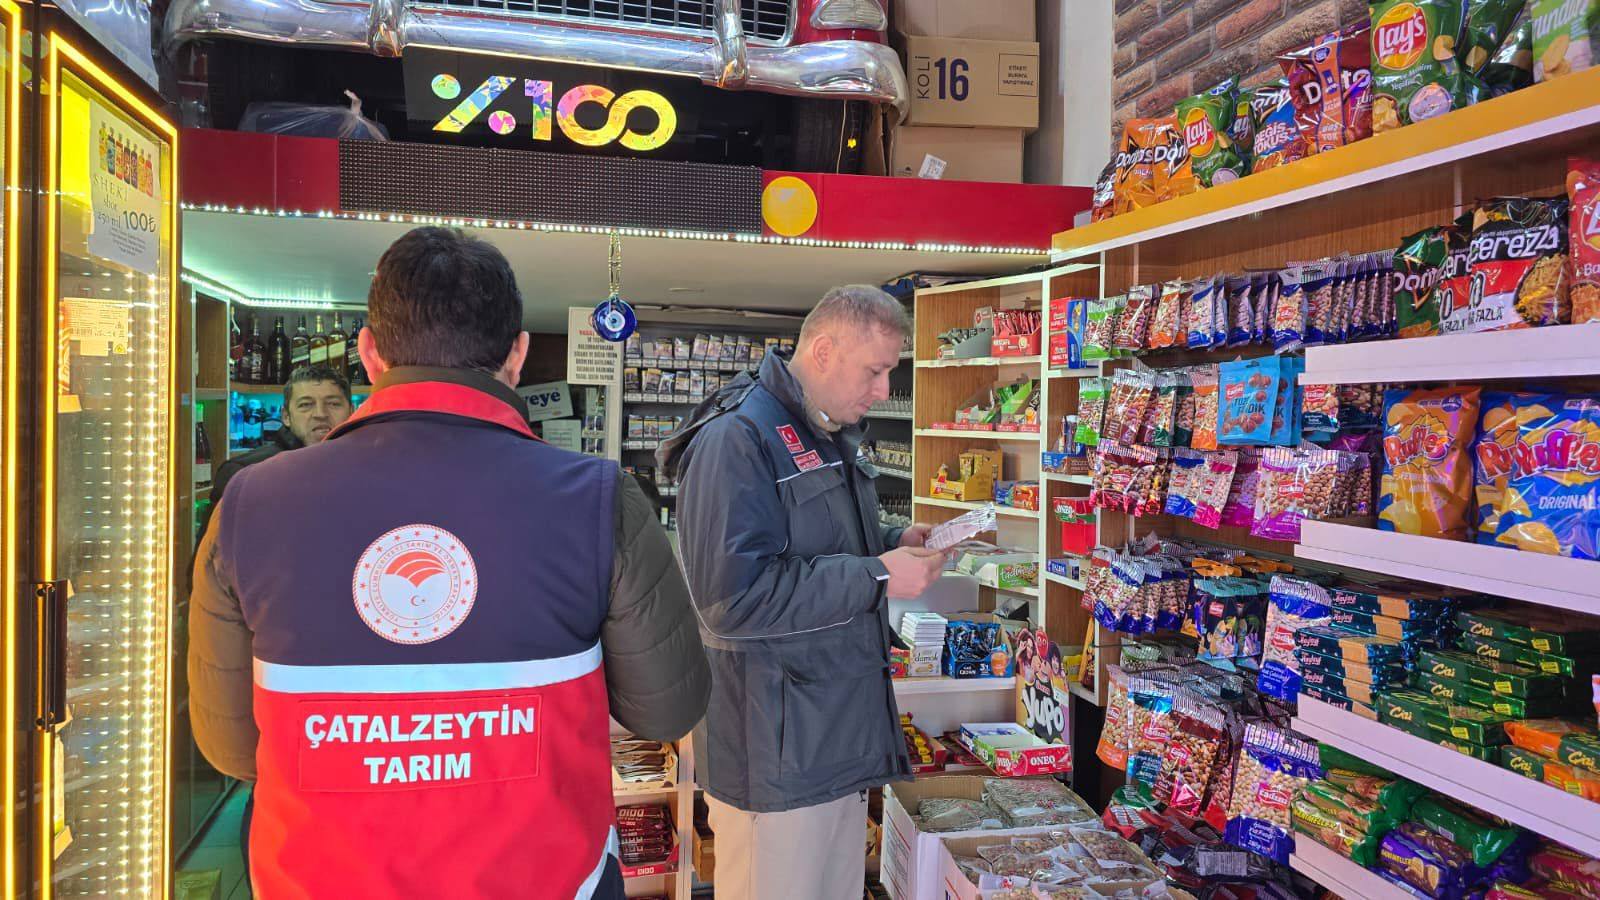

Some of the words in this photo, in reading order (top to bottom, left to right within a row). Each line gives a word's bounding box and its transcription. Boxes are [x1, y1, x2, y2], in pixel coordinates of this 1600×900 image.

[1378, 14, 1426, 58] Lay's
[934, 57, 969, 101] 16
[431, 73, 677, 151] %100
[1184, 115, 1213, 149] Lay's
[1539, 495, 1597, 510] ORIGINAL
[304, 703, 535, 748] ÇATALZEYTİN
[364, 752, 471, 784] TARIM
